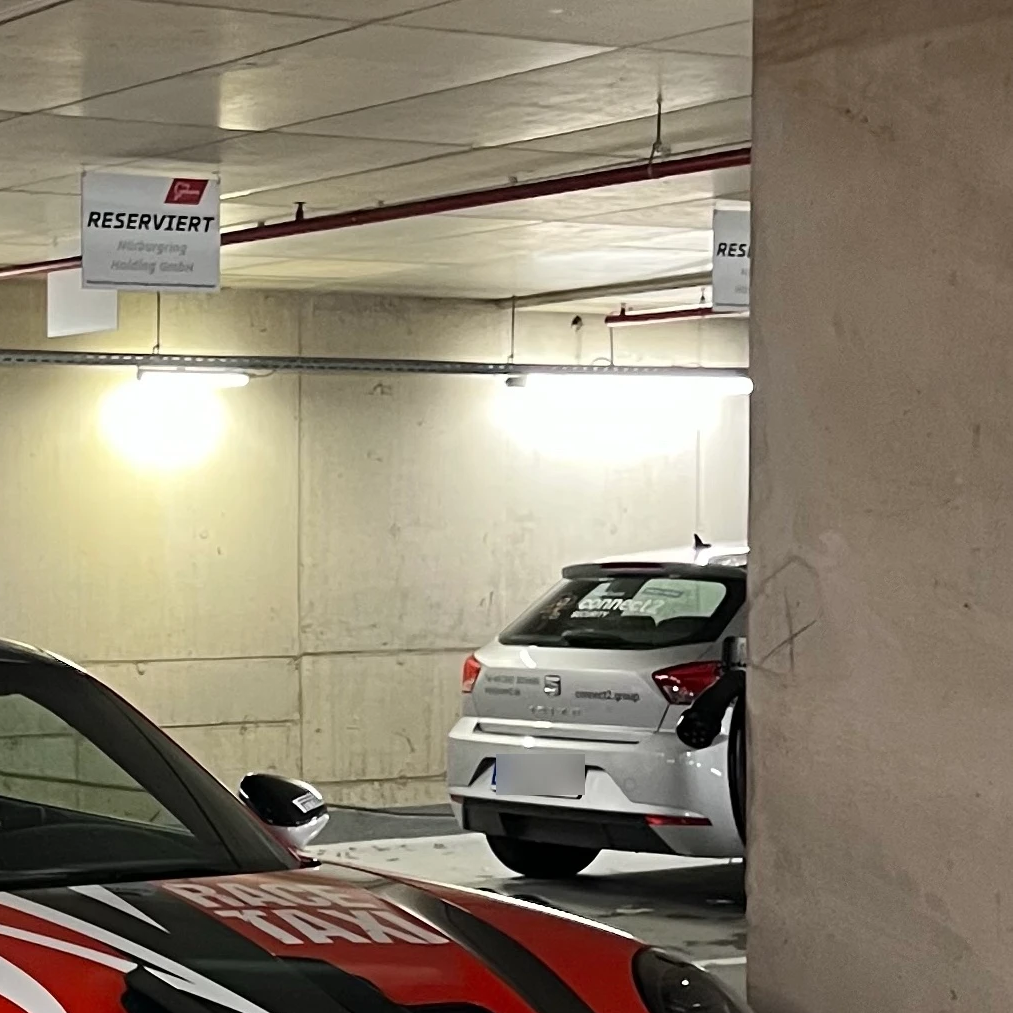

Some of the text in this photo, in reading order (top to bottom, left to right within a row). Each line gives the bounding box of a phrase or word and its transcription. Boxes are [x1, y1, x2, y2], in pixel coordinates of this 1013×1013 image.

[87, 211, 215, 233] RESERVIERT
[717, 242, 750, 257] RES
[161, 882, 378, 909] RACE
[214, 908, 451, 945] TAXI
